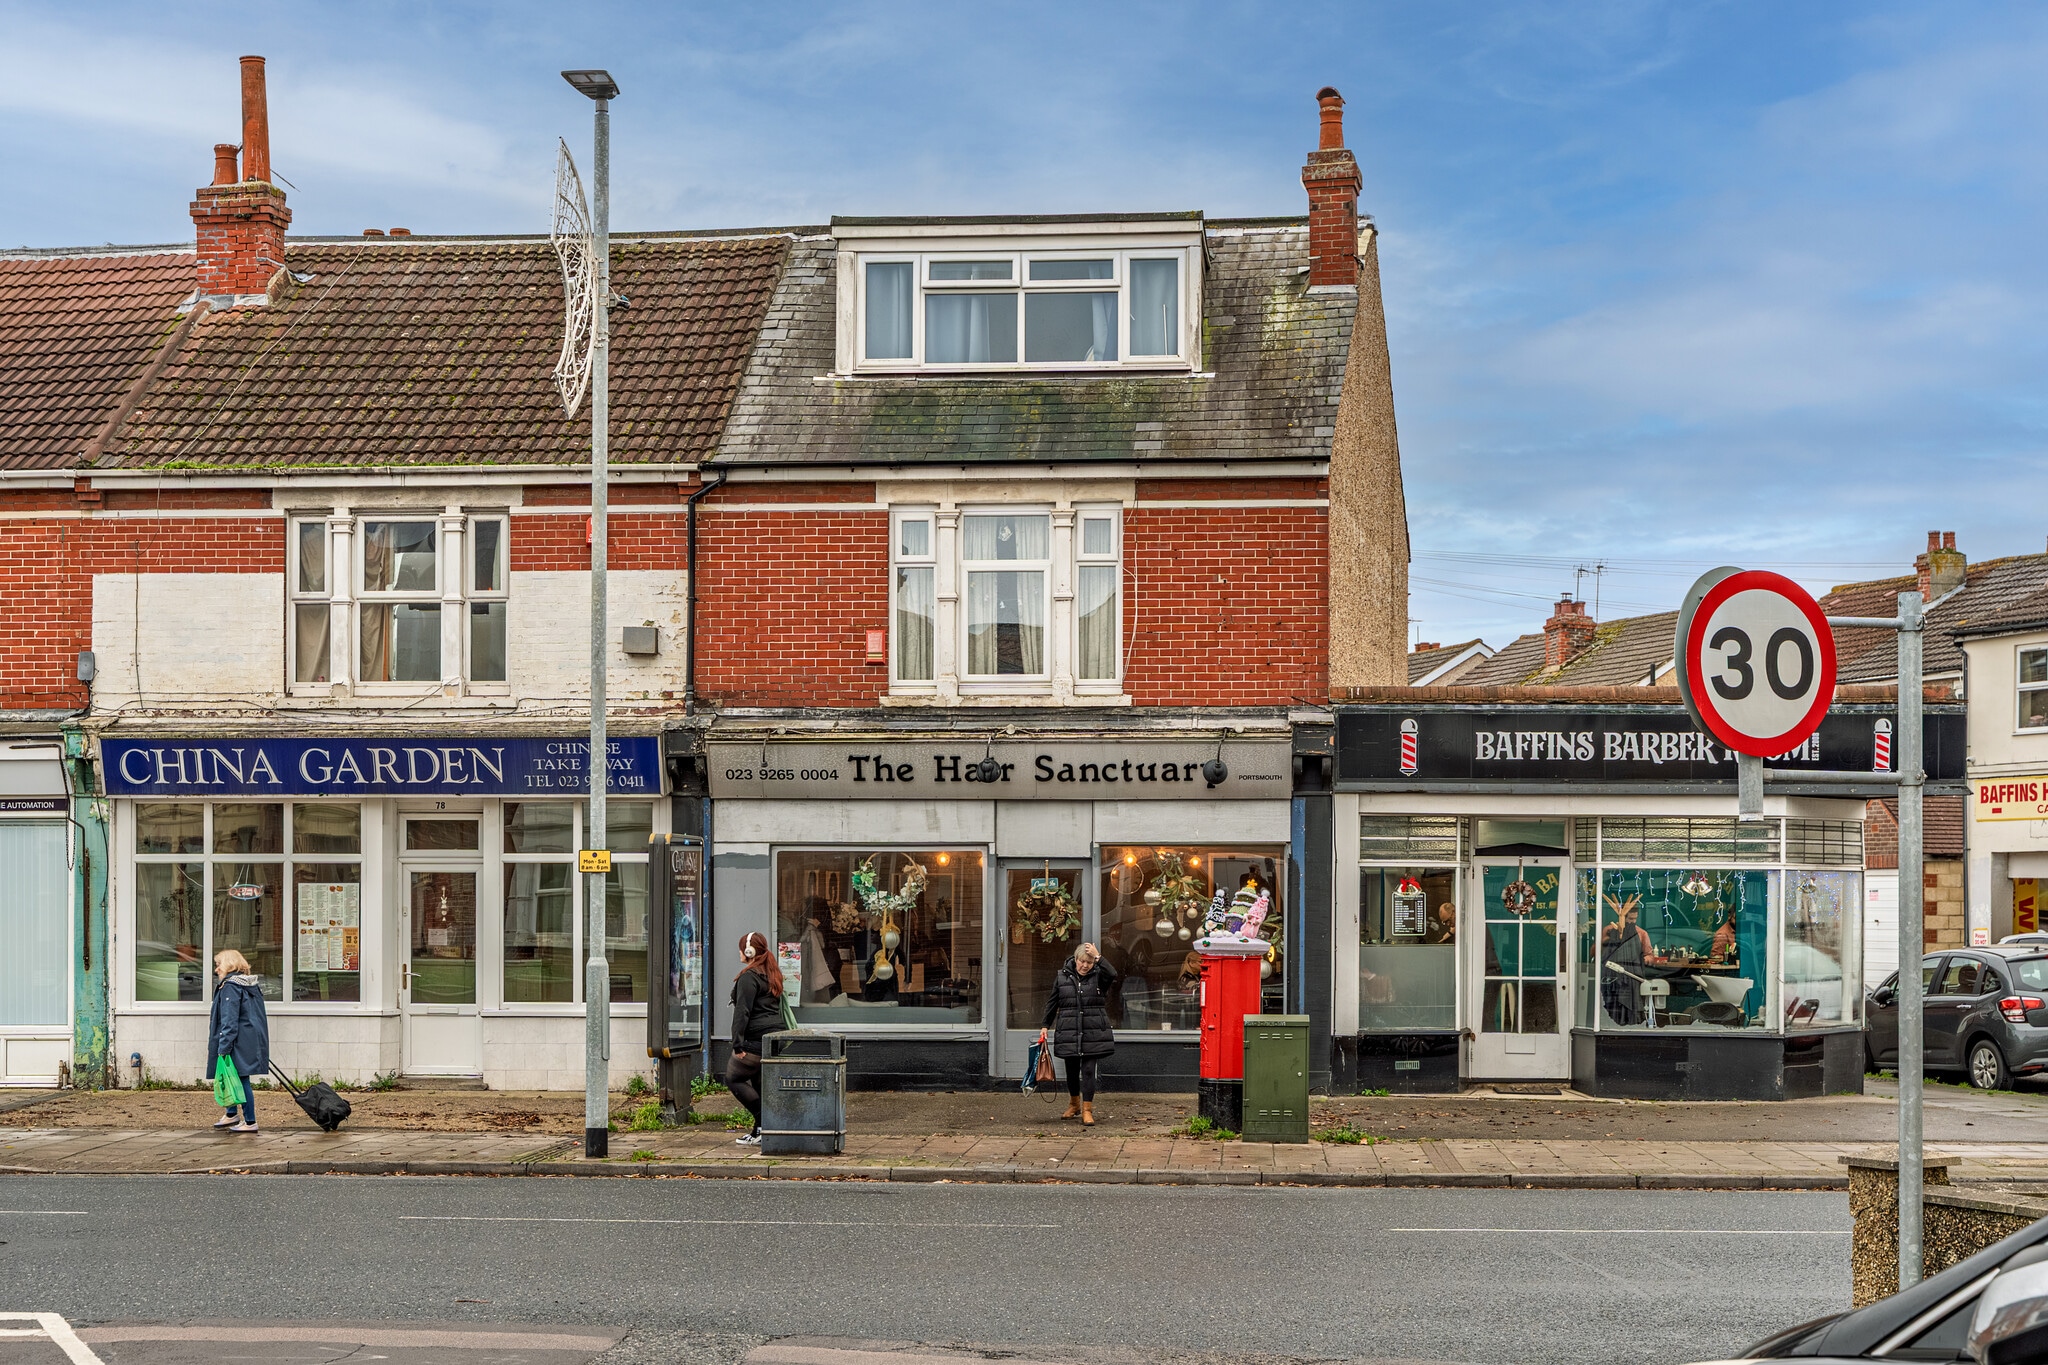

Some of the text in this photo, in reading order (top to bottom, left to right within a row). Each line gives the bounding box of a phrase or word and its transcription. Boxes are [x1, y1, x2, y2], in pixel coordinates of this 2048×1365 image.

[1709, 626, 1814, 701] 30
[546, 742, 622, 755] CHINSE
[1475, 731, 1595, 762] BAFFINS
[1602, 731, 1719, 765] BARBER
[119, 747, 505, 785] CHINA GARDEN
[533, 758, 635, 770] TAKE WAY
[725, 769, 840, 781] 023 9265 0004
[847, 755, 1217, 789] The Har Sanctuar
[523, 774, 645, 787] TEL 023 96 0411
[1980, 783, 2038, 804] BAFFINS
[7, 801, 55, 809] AUTOMATION
[435, 801, 446, 810] 78
[782, 1079, 818, 1087] LITTER
